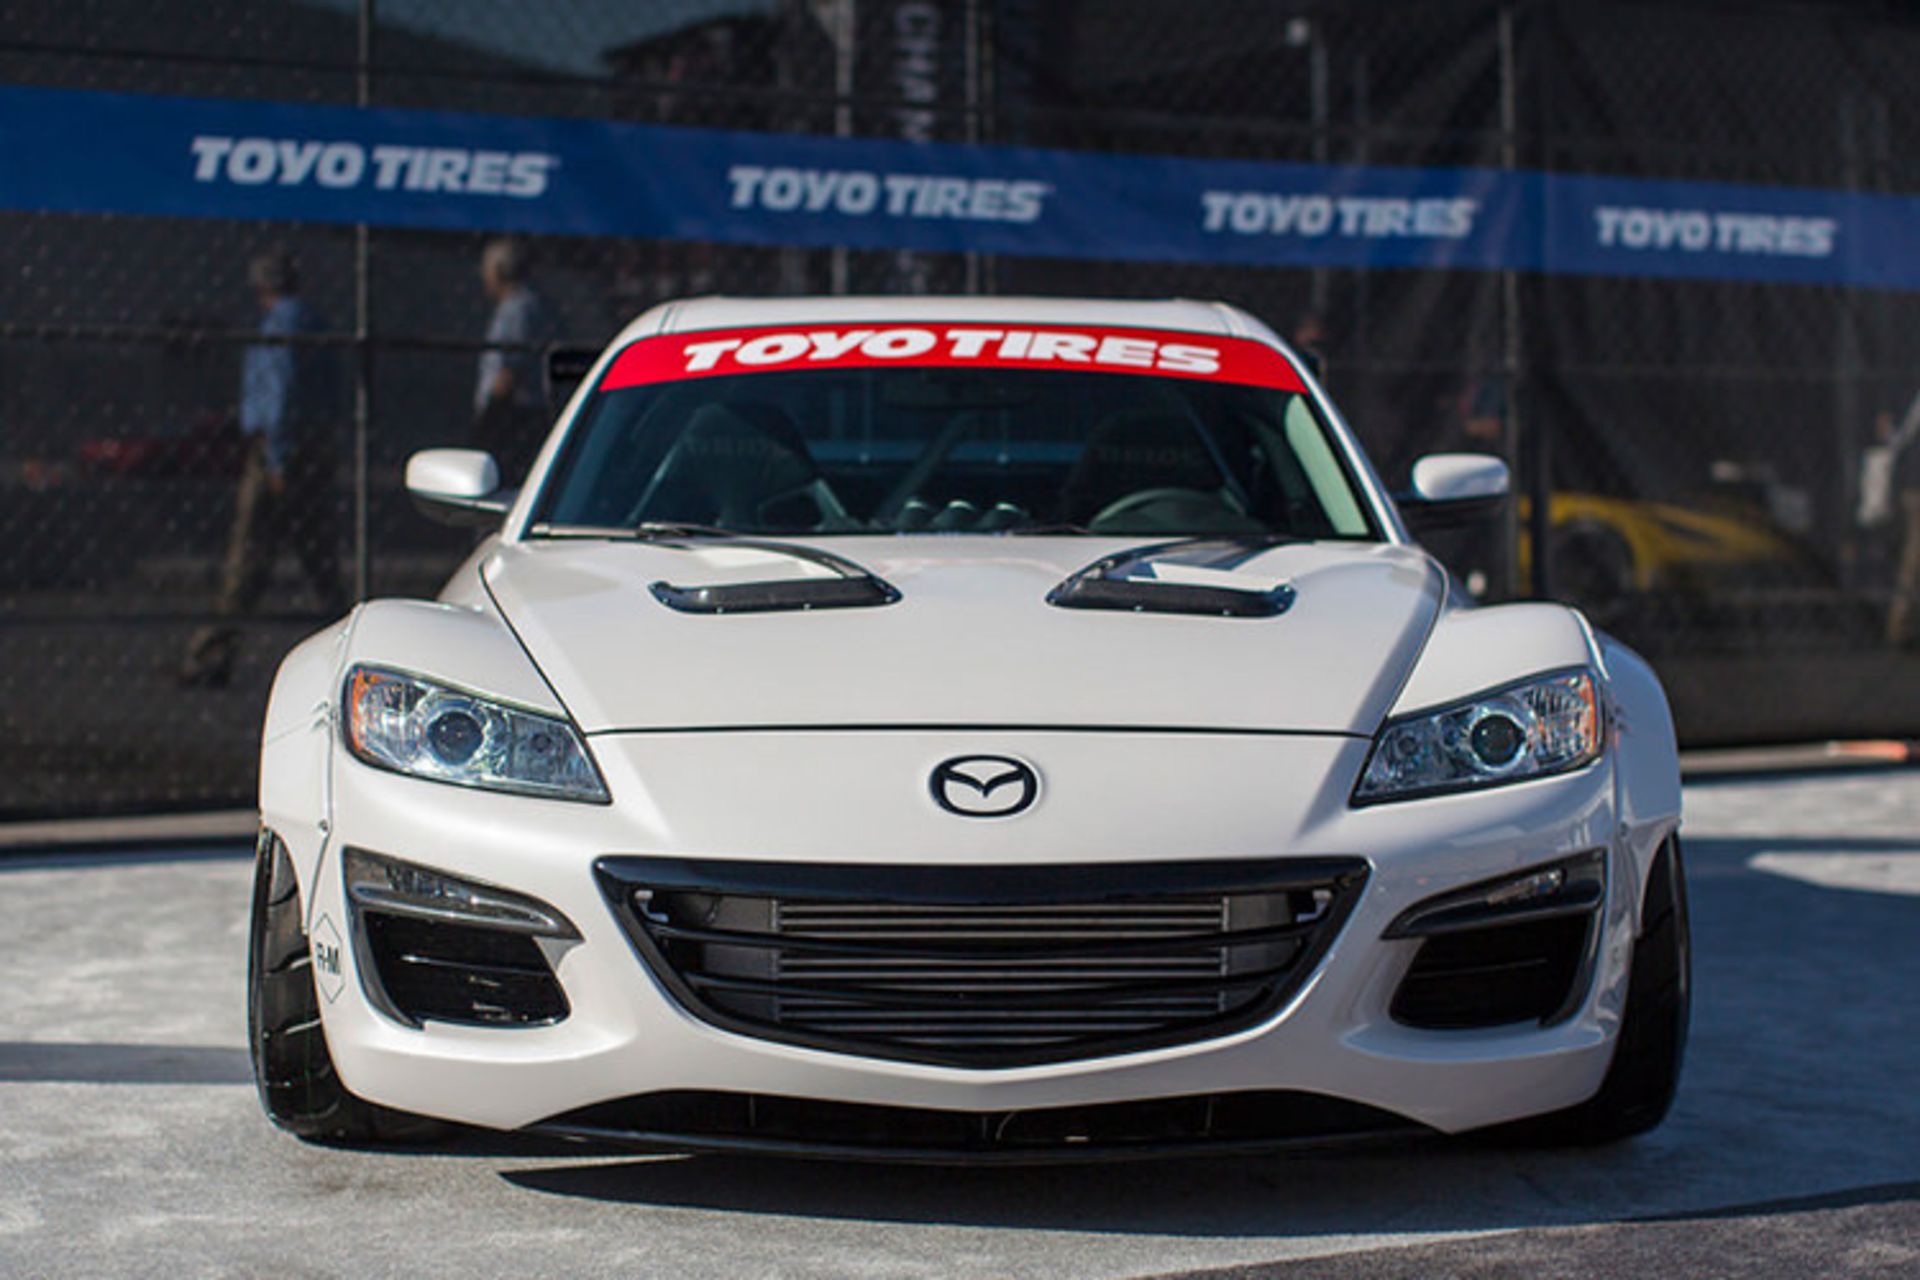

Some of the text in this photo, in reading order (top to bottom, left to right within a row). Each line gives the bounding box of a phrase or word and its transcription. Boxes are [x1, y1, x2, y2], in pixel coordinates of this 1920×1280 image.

[192, 136, 551, 197] TOYO TIRES
[729, 167, 1044, 222] TOYO TIRES
[1203, 191, 1475, 238] TOYO TIRES
[1595, 207, 1836, 256] TOYO TIRES
[684, 328, 1220, 374] TOYO TIRES
